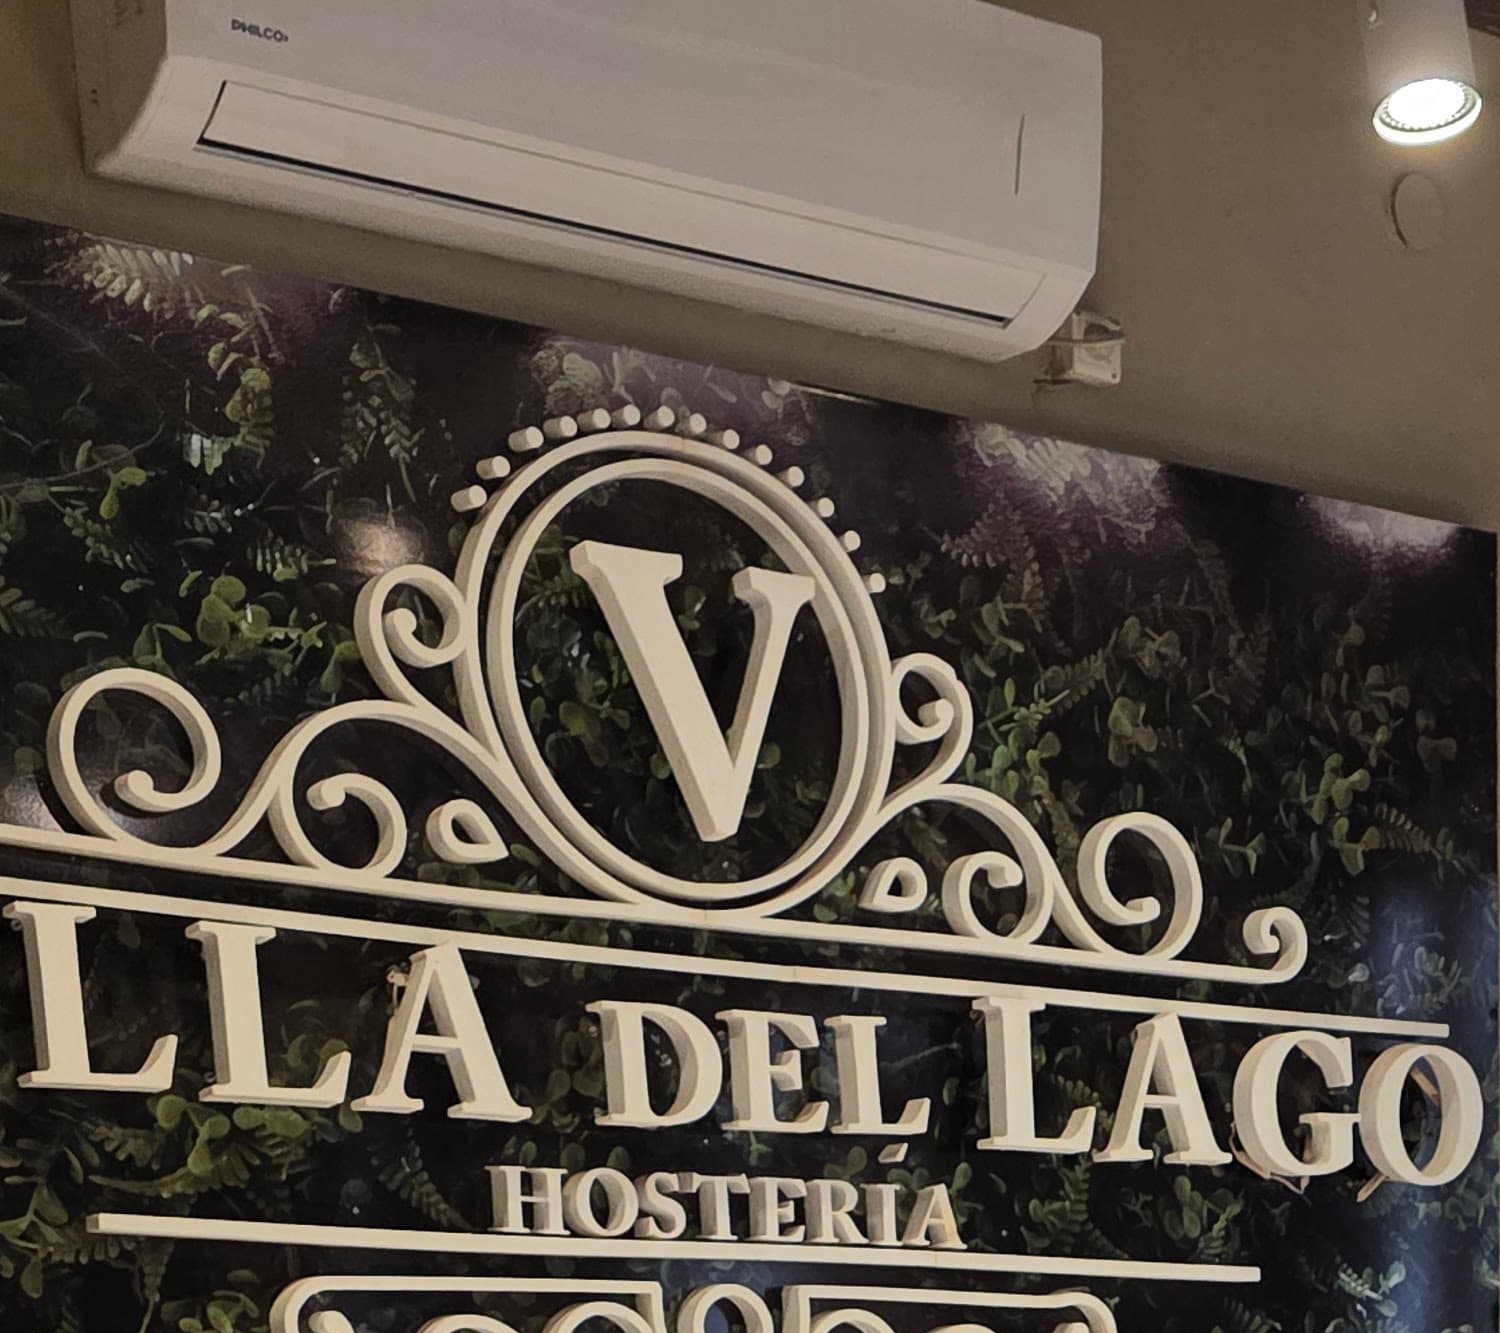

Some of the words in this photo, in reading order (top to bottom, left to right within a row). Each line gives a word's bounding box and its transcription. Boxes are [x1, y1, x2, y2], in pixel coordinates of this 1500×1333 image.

[570, 539, 815, 843] V
[3, 900, 533, 1122] LLA
[585, 1001, 930, 1135] DEL
[972, 995, 1482, 1187] LAGO
[485, 1143, 967, 1250] HOSTERÍA
